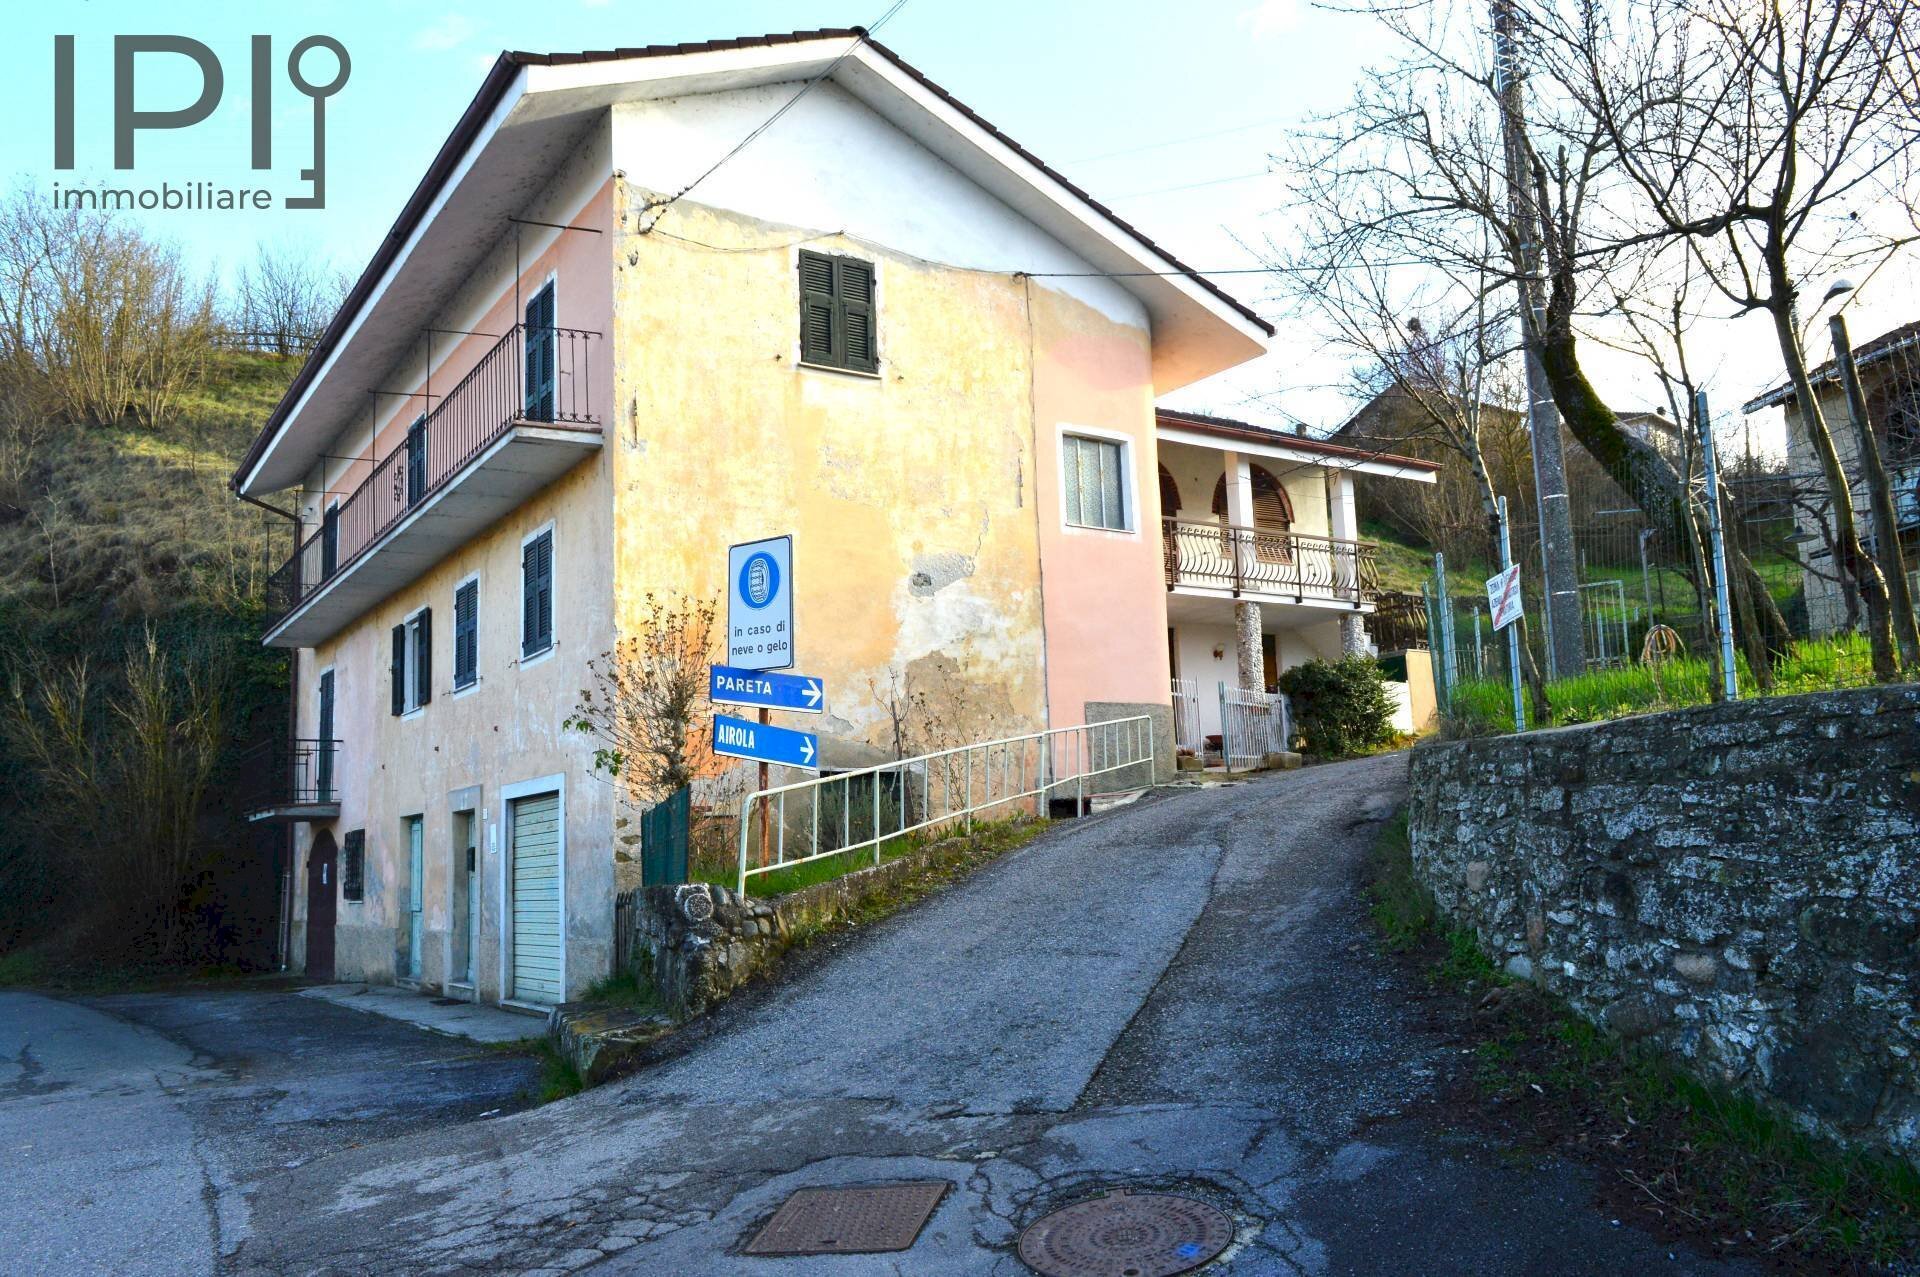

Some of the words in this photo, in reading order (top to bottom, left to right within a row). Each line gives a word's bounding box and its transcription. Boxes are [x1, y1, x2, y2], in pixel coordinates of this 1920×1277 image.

[734, 626, 743, 637] in
[747, 625, 771, 636] caso
[776, 620, 785, 632] di
[731, 645, 754, 656] neve
[757, 644, 763, 653] o
[766, 639, 788, 654] gelo
[716, 675, 772, 696] PARETA
[717, 724, 755, 749] AIROLA
